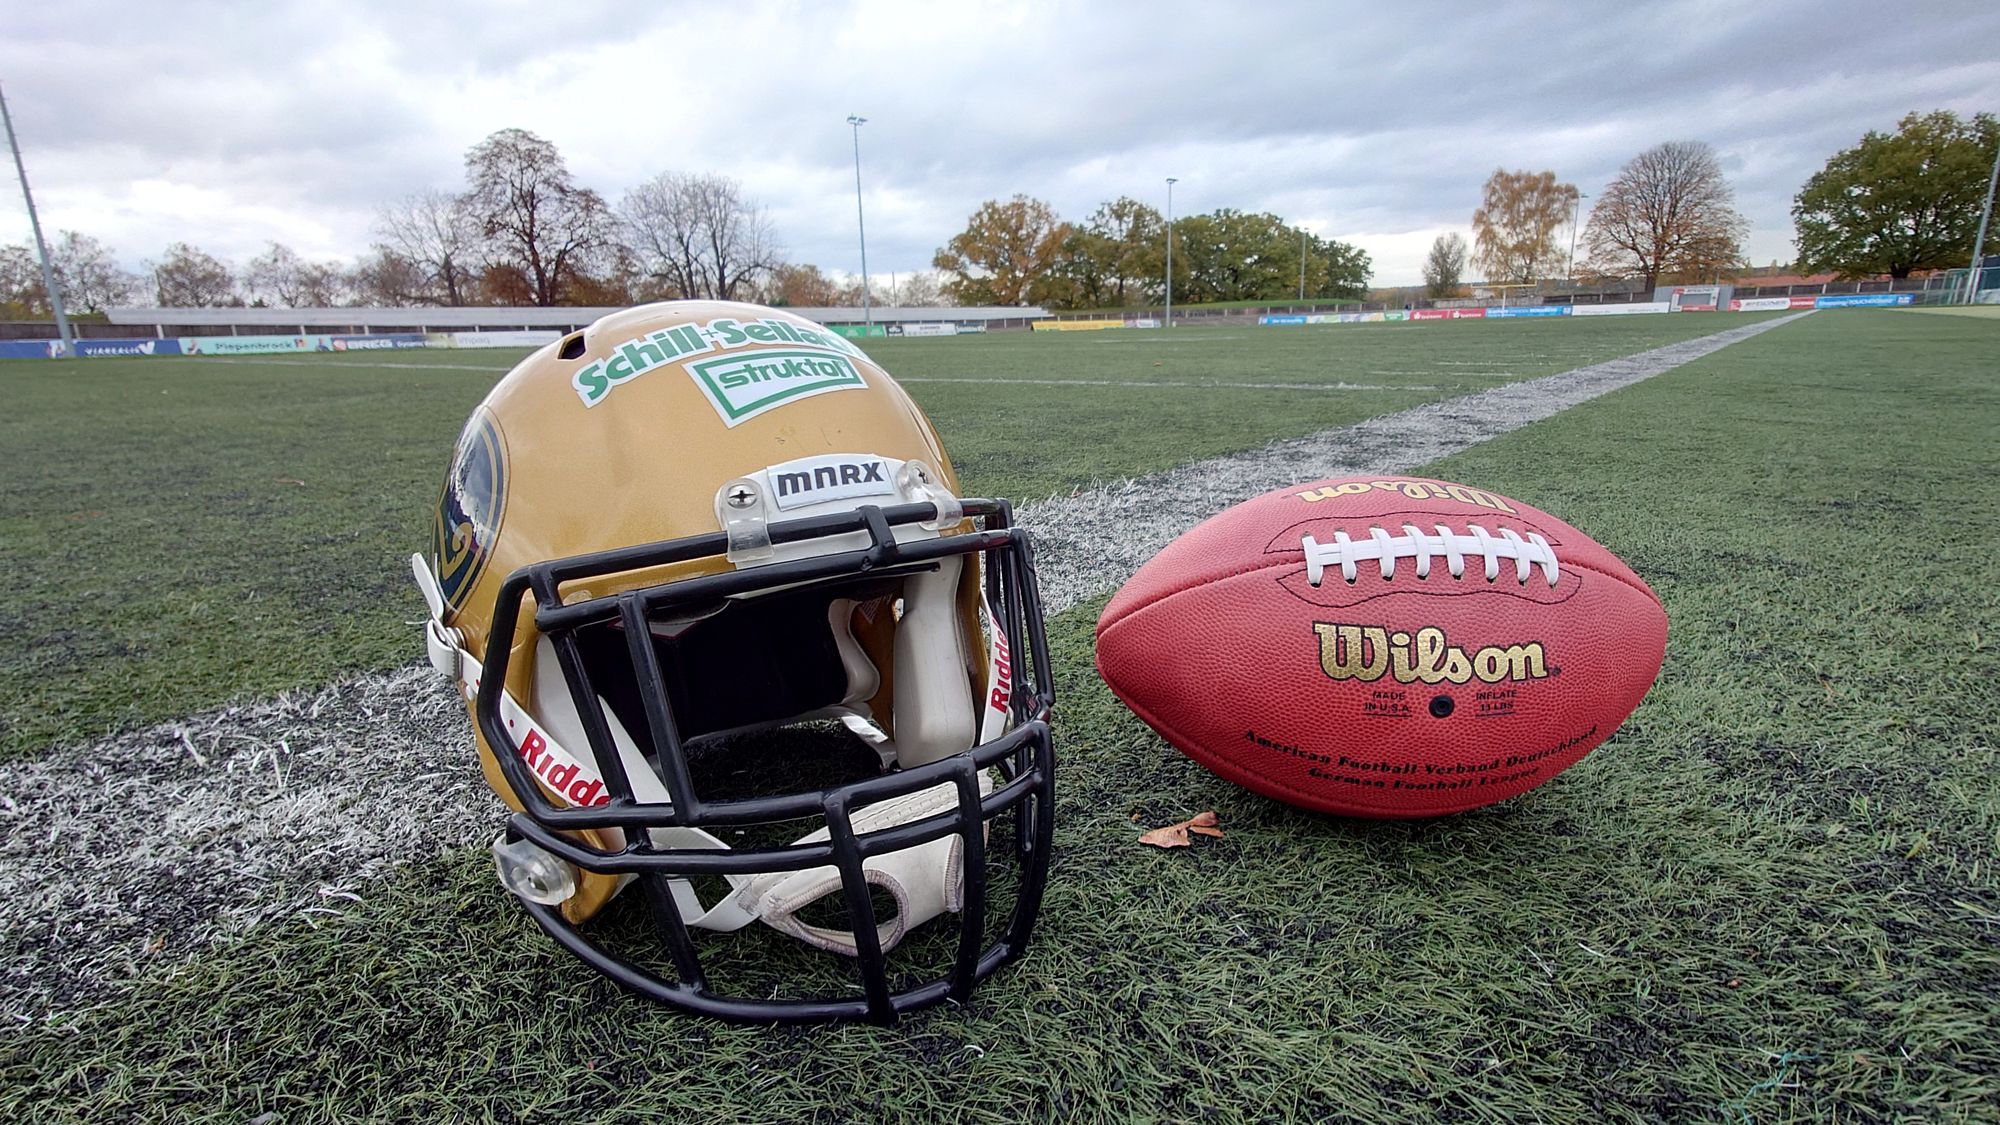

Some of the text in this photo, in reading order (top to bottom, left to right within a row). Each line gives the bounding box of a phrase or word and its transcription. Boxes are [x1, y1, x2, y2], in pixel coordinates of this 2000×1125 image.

[1372, 691, 1406, 700] MADE
[1476, 690, 1518, 700] INFLATE
[1365, 702, 1376, 710] IN
[1244, 725, 1598, 775] American Football Verband Deutschland
[1308, 767, 1540, 791] German Football League
